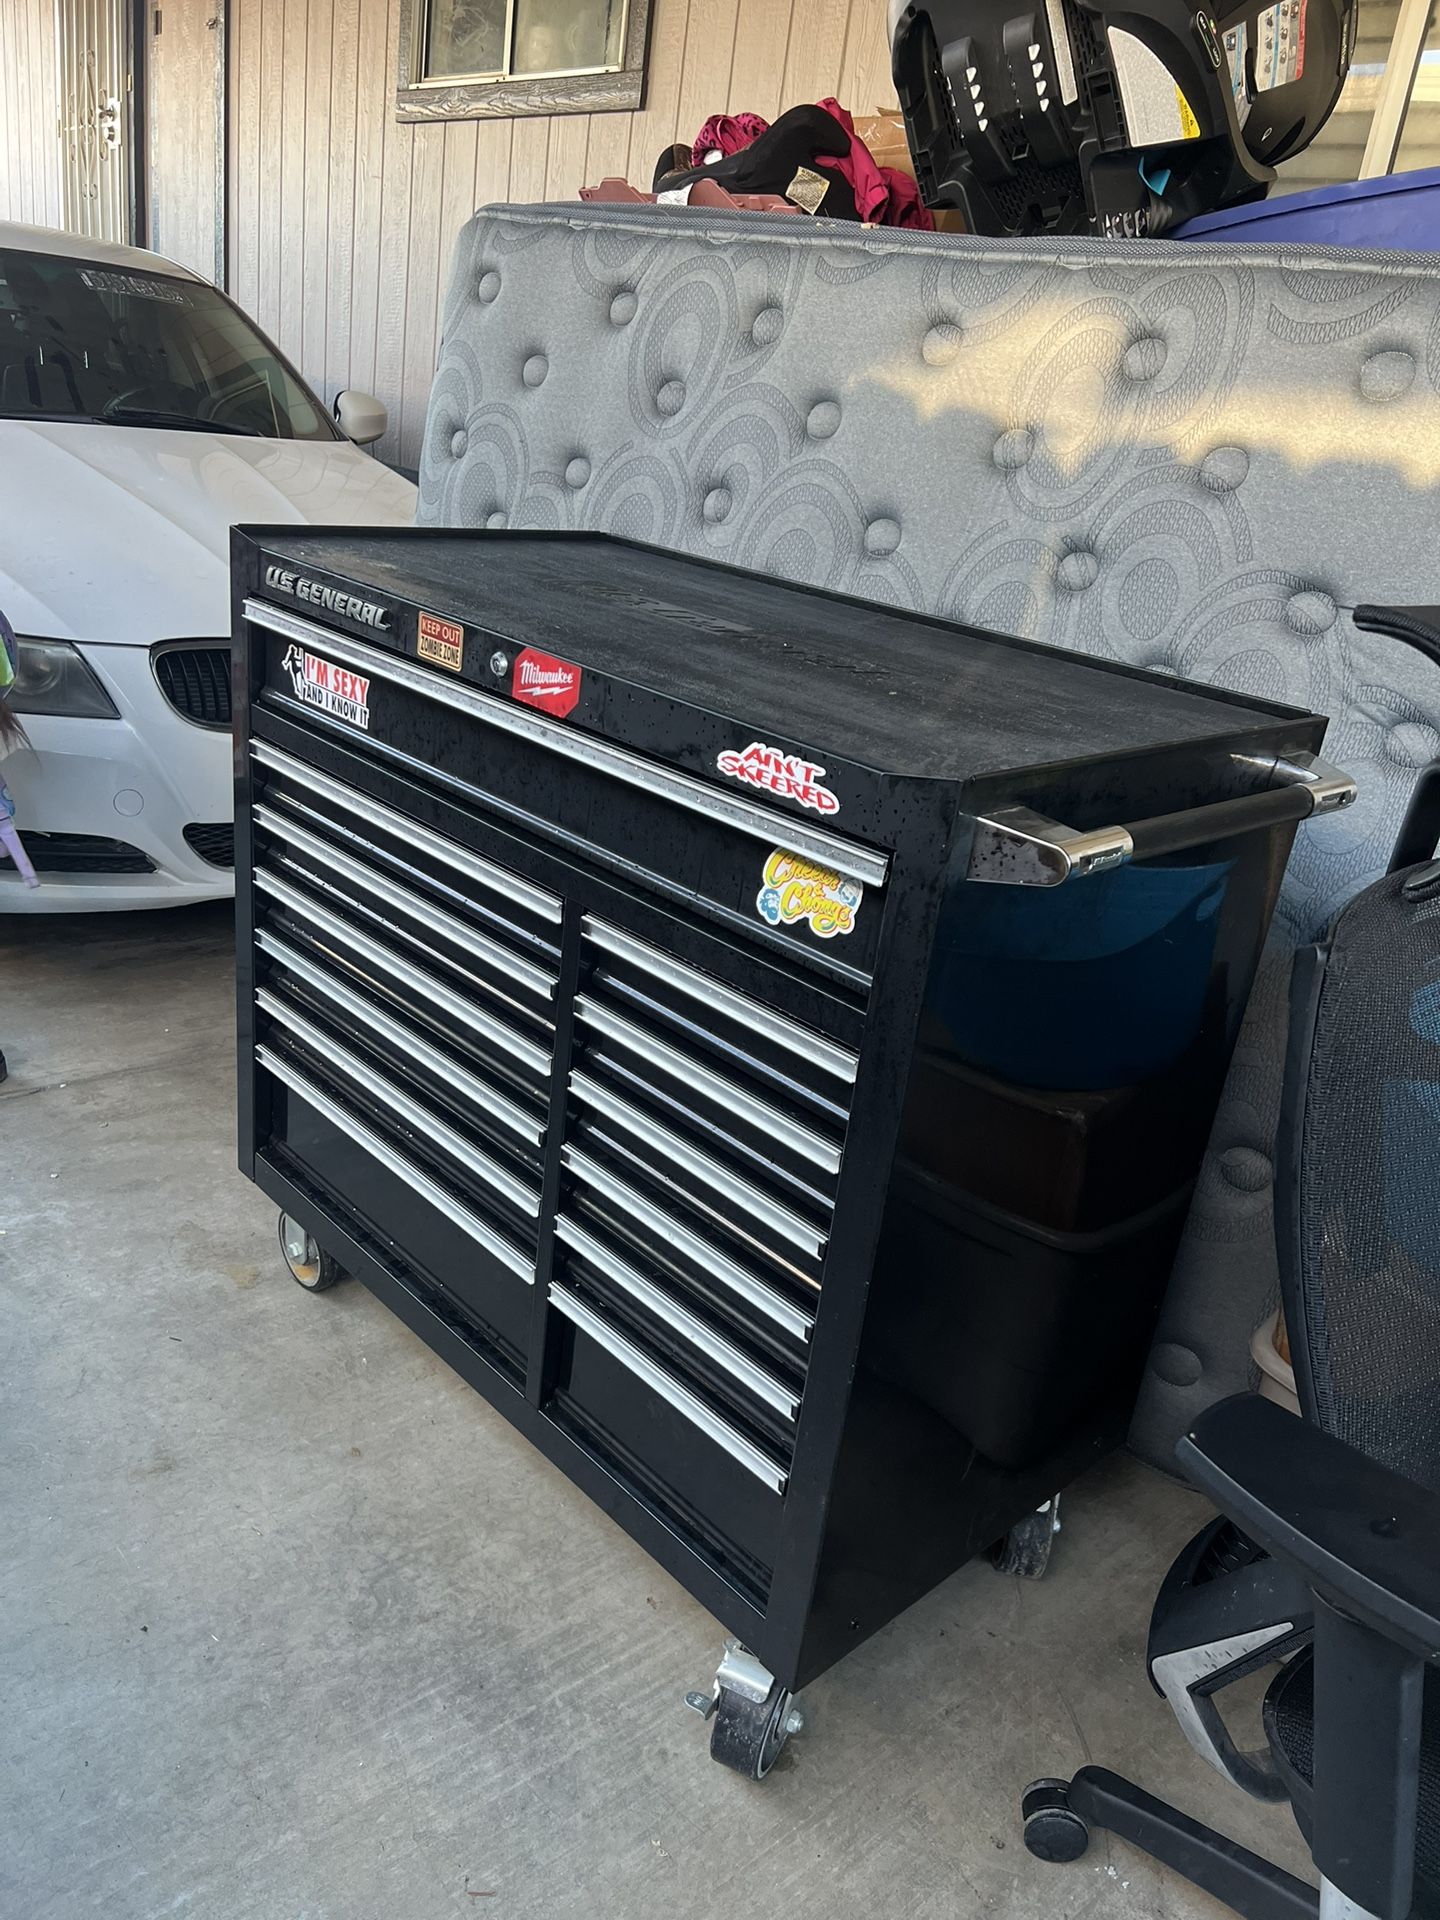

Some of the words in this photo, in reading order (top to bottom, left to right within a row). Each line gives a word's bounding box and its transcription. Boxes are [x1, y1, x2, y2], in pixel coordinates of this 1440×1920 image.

[296, 578, 392, 631] GENERAL
[422, 618, 441, 636] KEEP
[442, 626, 460, 644] OUT
[443, 644, 460, 665] ZONE
[305, 655, 328, 688] I'M
[333, 667, 368, 705] SEXY
[519, 659, 574, 685] Milwaukee
[306, 683, 323, 704] AND
[331, 694, 358, 721] KNOW
[360, 708, 368, 726] IT
[743, 748, 823, 782] AIN'T
[720, 756, 836, 810] SKEERED
[813, 882, 826, 897] &
